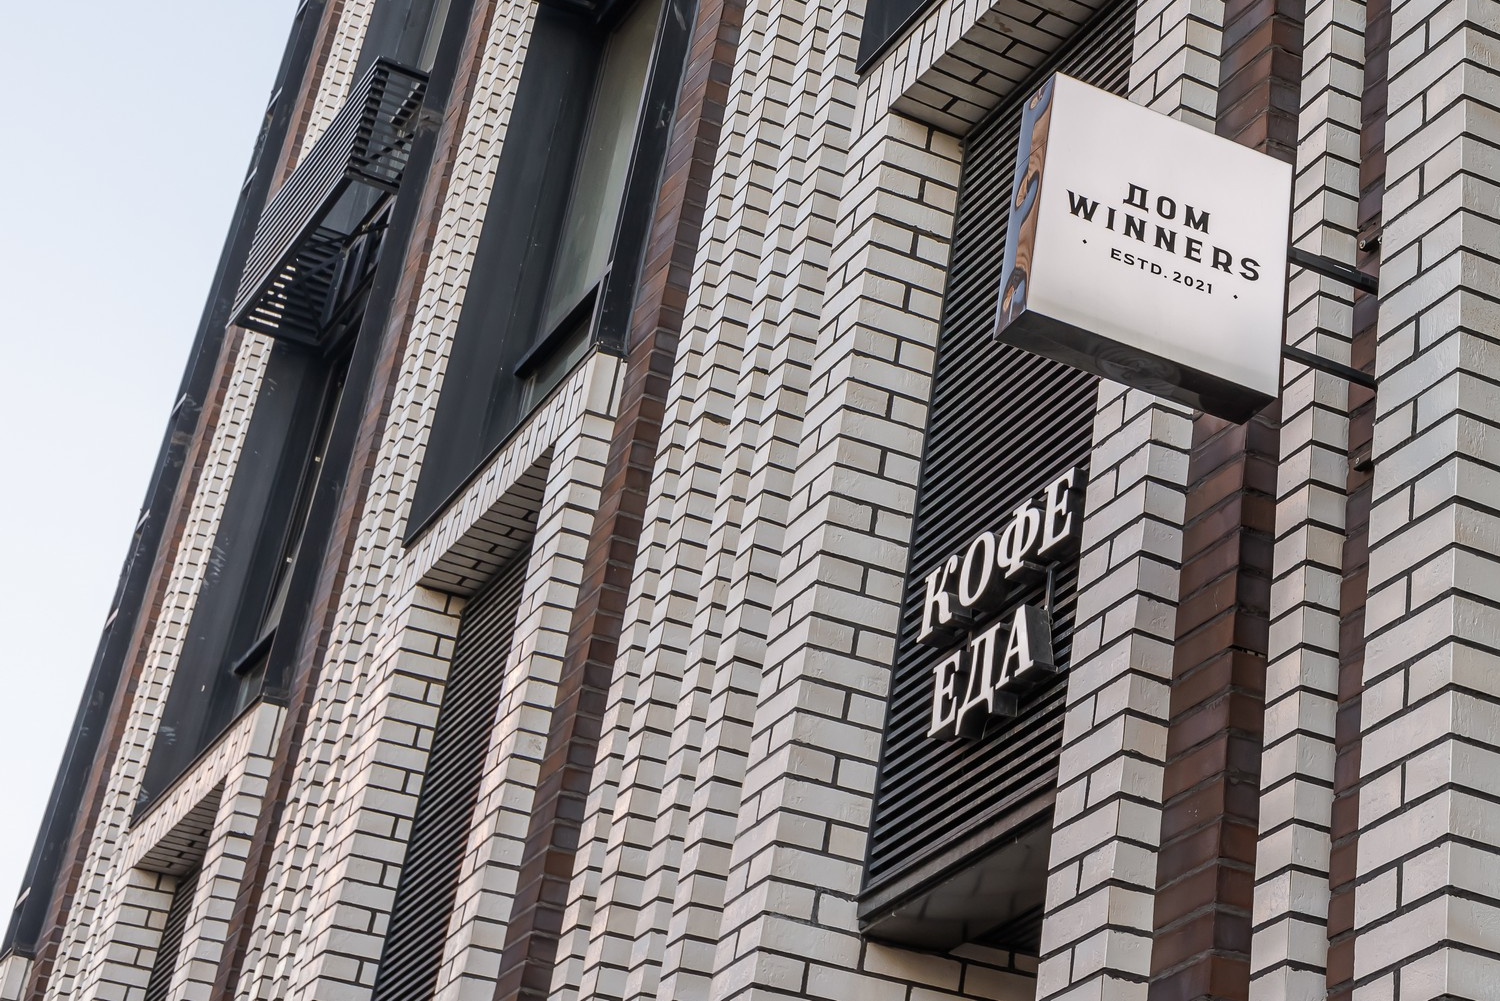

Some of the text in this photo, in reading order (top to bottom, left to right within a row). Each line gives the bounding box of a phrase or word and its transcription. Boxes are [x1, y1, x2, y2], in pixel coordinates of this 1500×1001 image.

[1065, 189, 1262, 282] WINNERS
[1122, 182, 1211, 235] ДОМ
[1109, 247, 1214, 295] ESTD. 2021
[916, 467, 1076, 644] КОФЕ
[926, 603, 1034, 739] ЕДА
